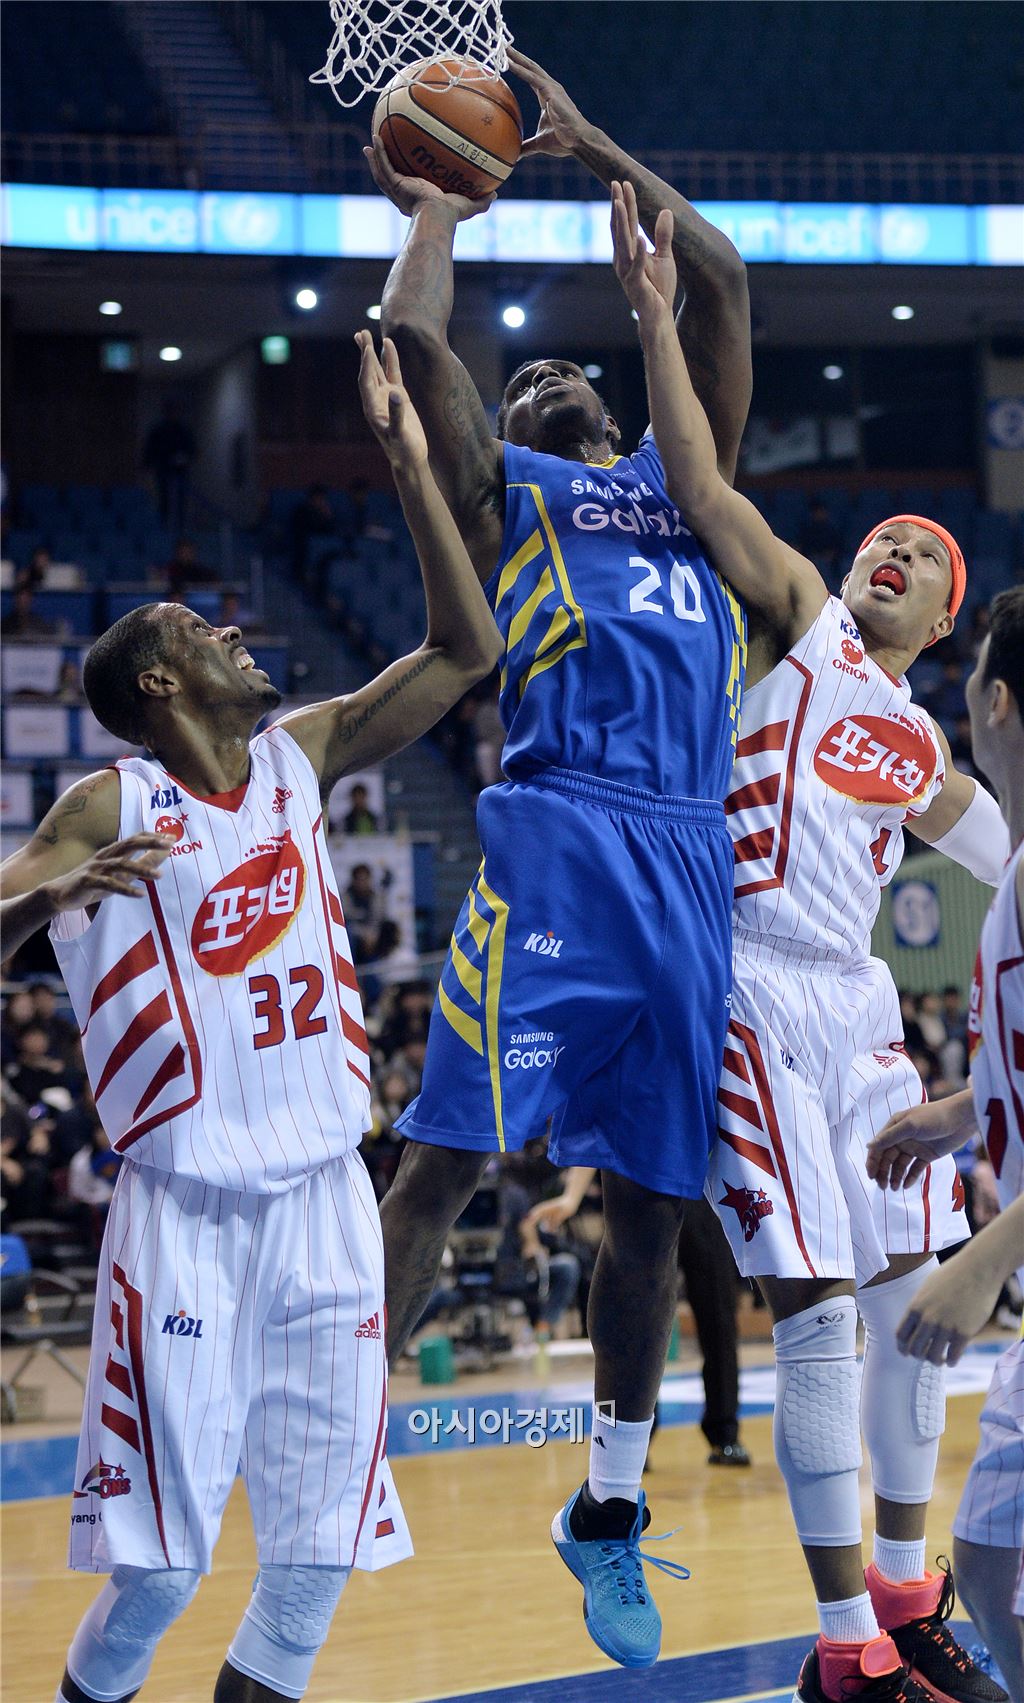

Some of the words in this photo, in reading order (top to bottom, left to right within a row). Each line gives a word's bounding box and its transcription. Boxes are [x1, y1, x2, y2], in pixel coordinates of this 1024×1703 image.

[64, 192, 219, 244] unicef
[571, 479, 653, 502] SAMSNG
[572, 502, 692, 537] Galax
[629, 556, 706, 623] 20
[832, 658, 870, 684] ORION
[150, 785, 182, 810] KBL
[169, 840, 203, 857] RION
[523, 932, 564, 959] KBL
[248, 964, 328, 1051] 32
[510, 1031, 554, 1045] SAMSUNG
[161, 1314, 203, 1339] KBL
